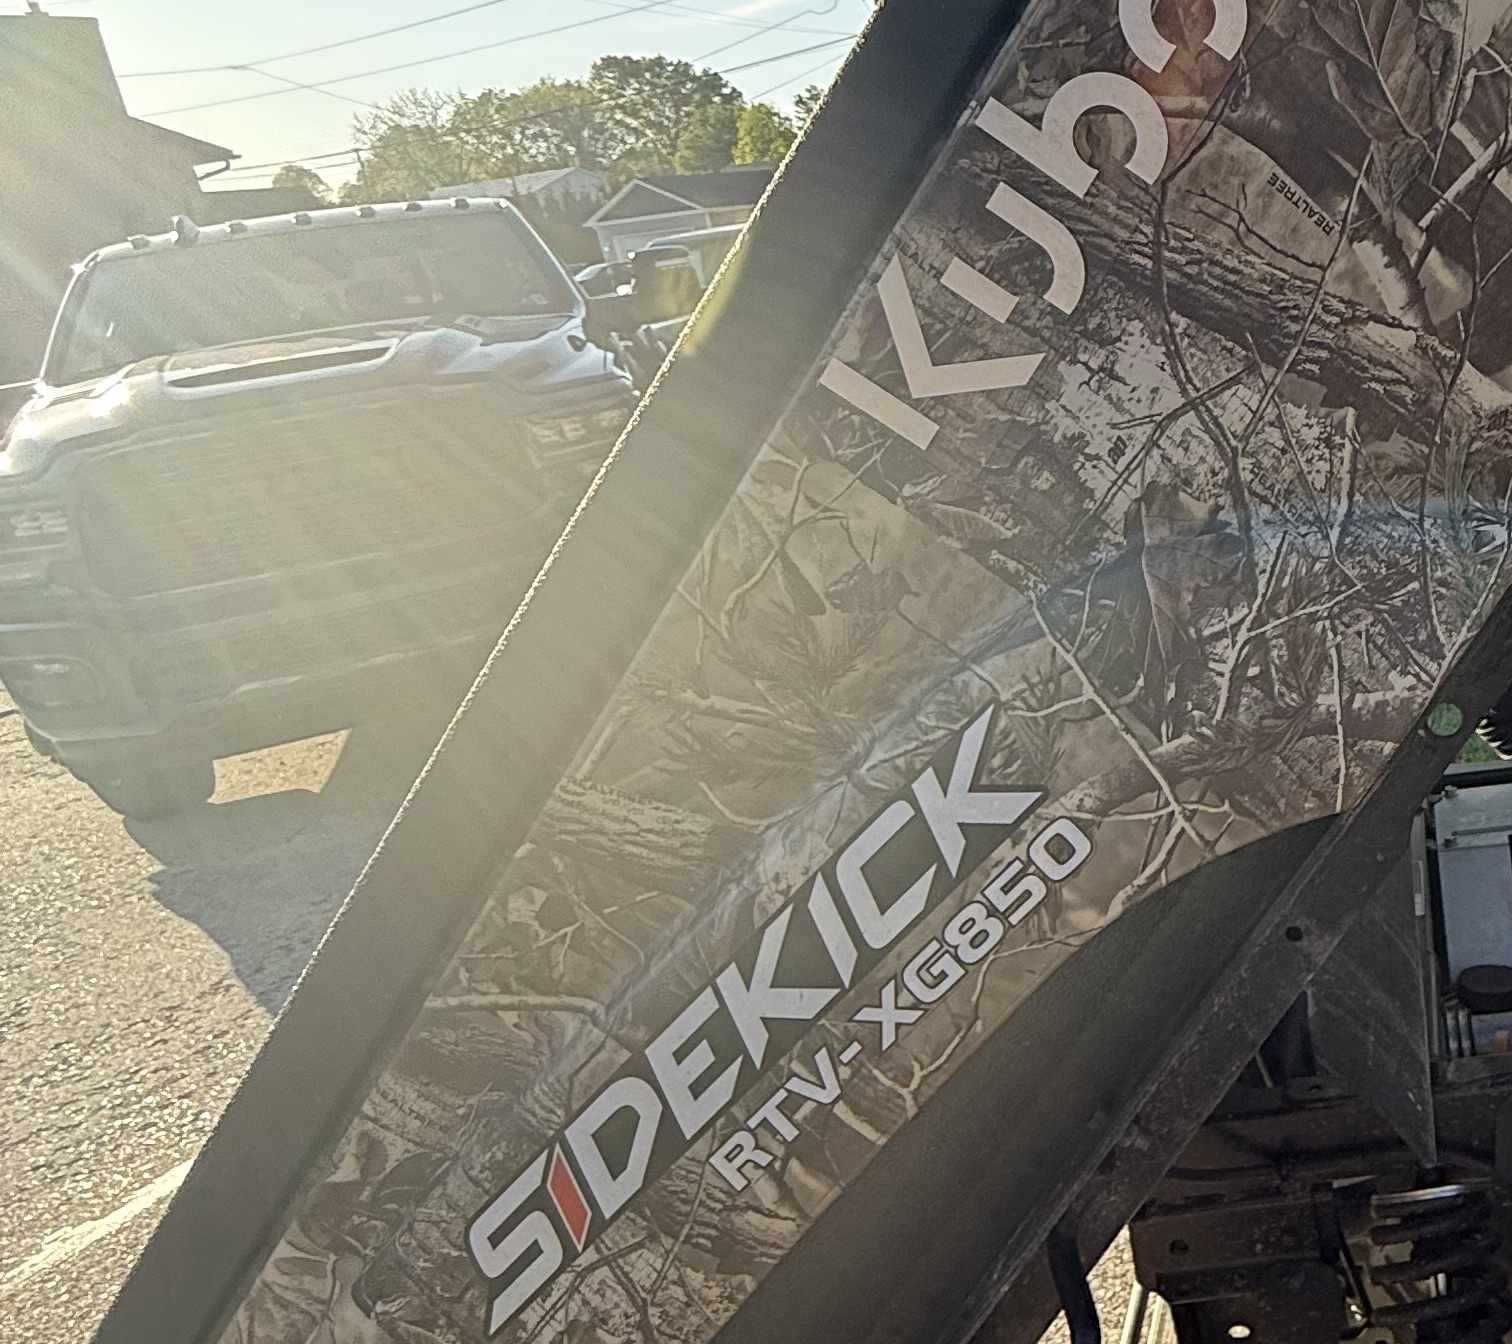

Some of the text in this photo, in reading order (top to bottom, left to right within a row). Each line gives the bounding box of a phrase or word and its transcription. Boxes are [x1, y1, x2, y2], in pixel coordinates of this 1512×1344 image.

[1267, 172, 1335, 236] REALTREE
[468, 705, 1043, 1335] SIDEKICK
[708, 819, 1092, 1193] RTV-XG850
